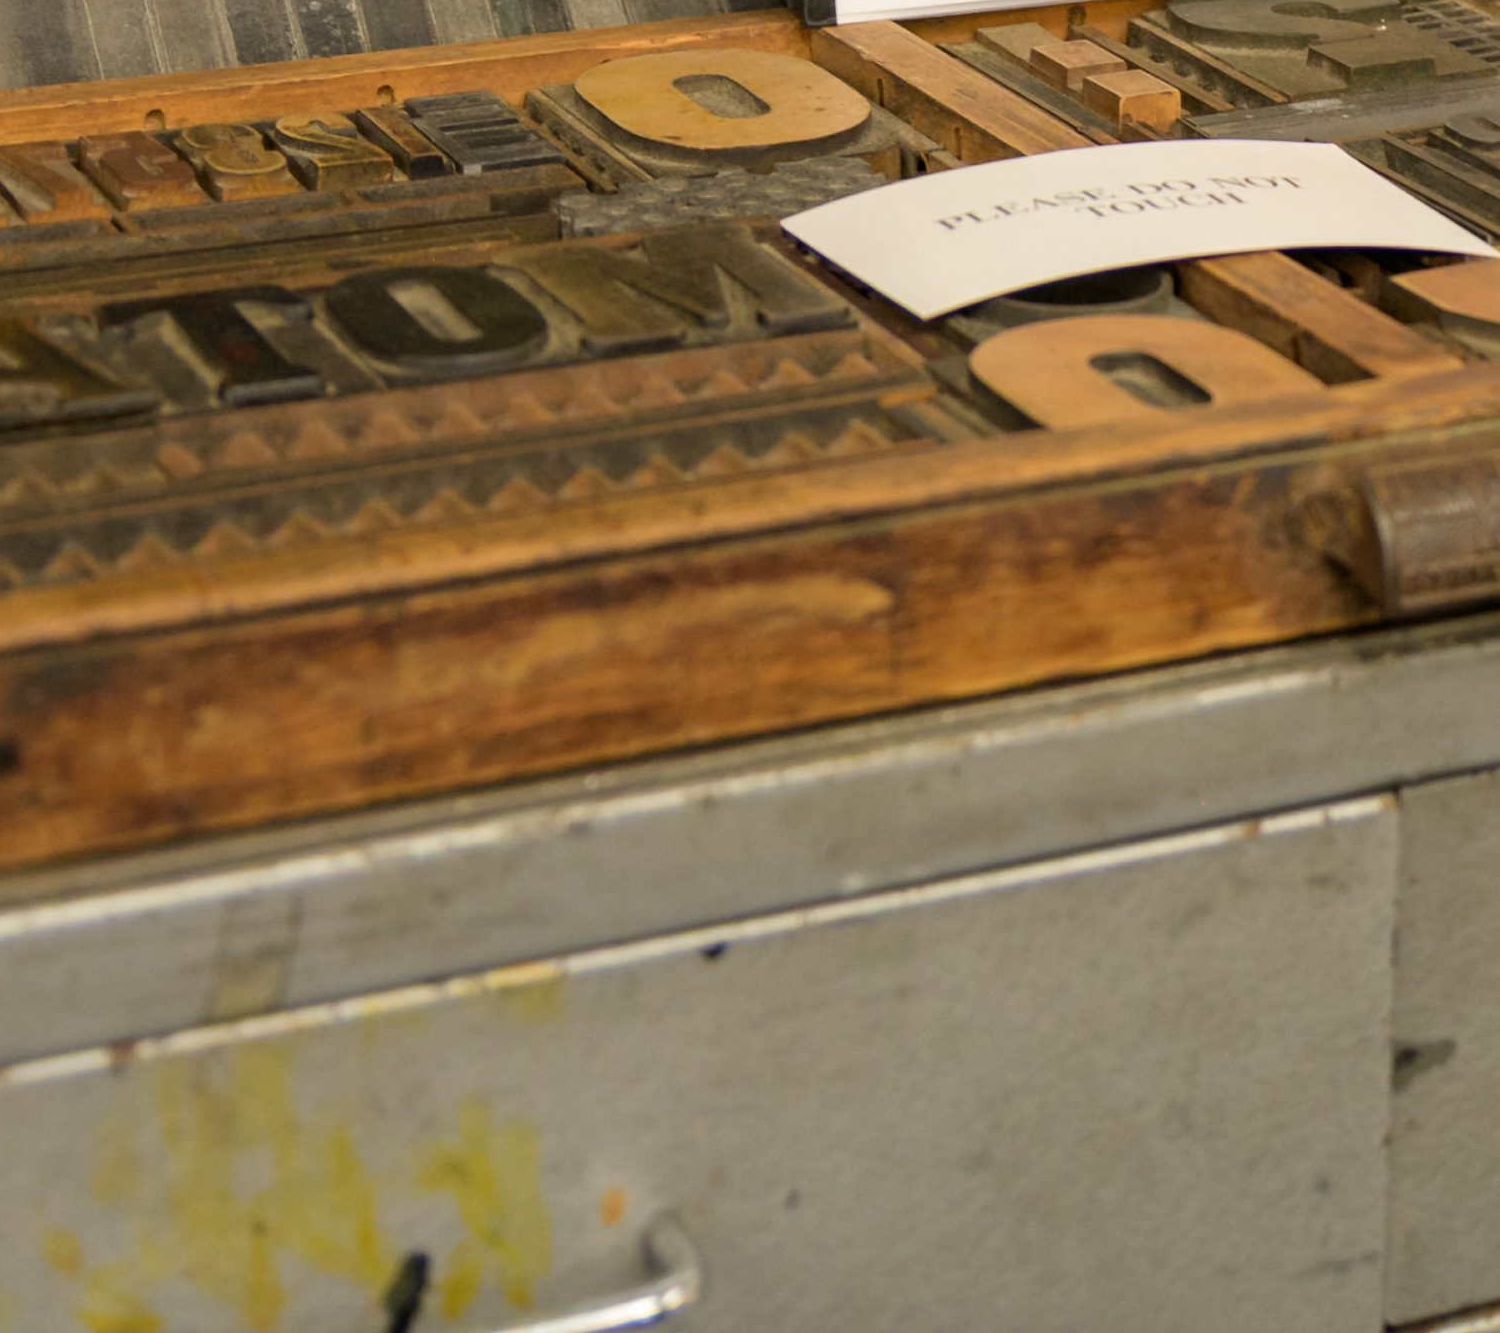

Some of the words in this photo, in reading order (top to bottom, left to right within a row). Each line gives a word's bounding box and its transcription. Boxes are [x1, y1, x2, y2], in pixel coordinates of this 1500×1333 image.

[935, 187, 1117, 231] PLEASE
[1126, 178, 1197, 198] DO
[1209, 174, 1305, 191] NOT
[1075, 191, 1248, 220] TOUCH
